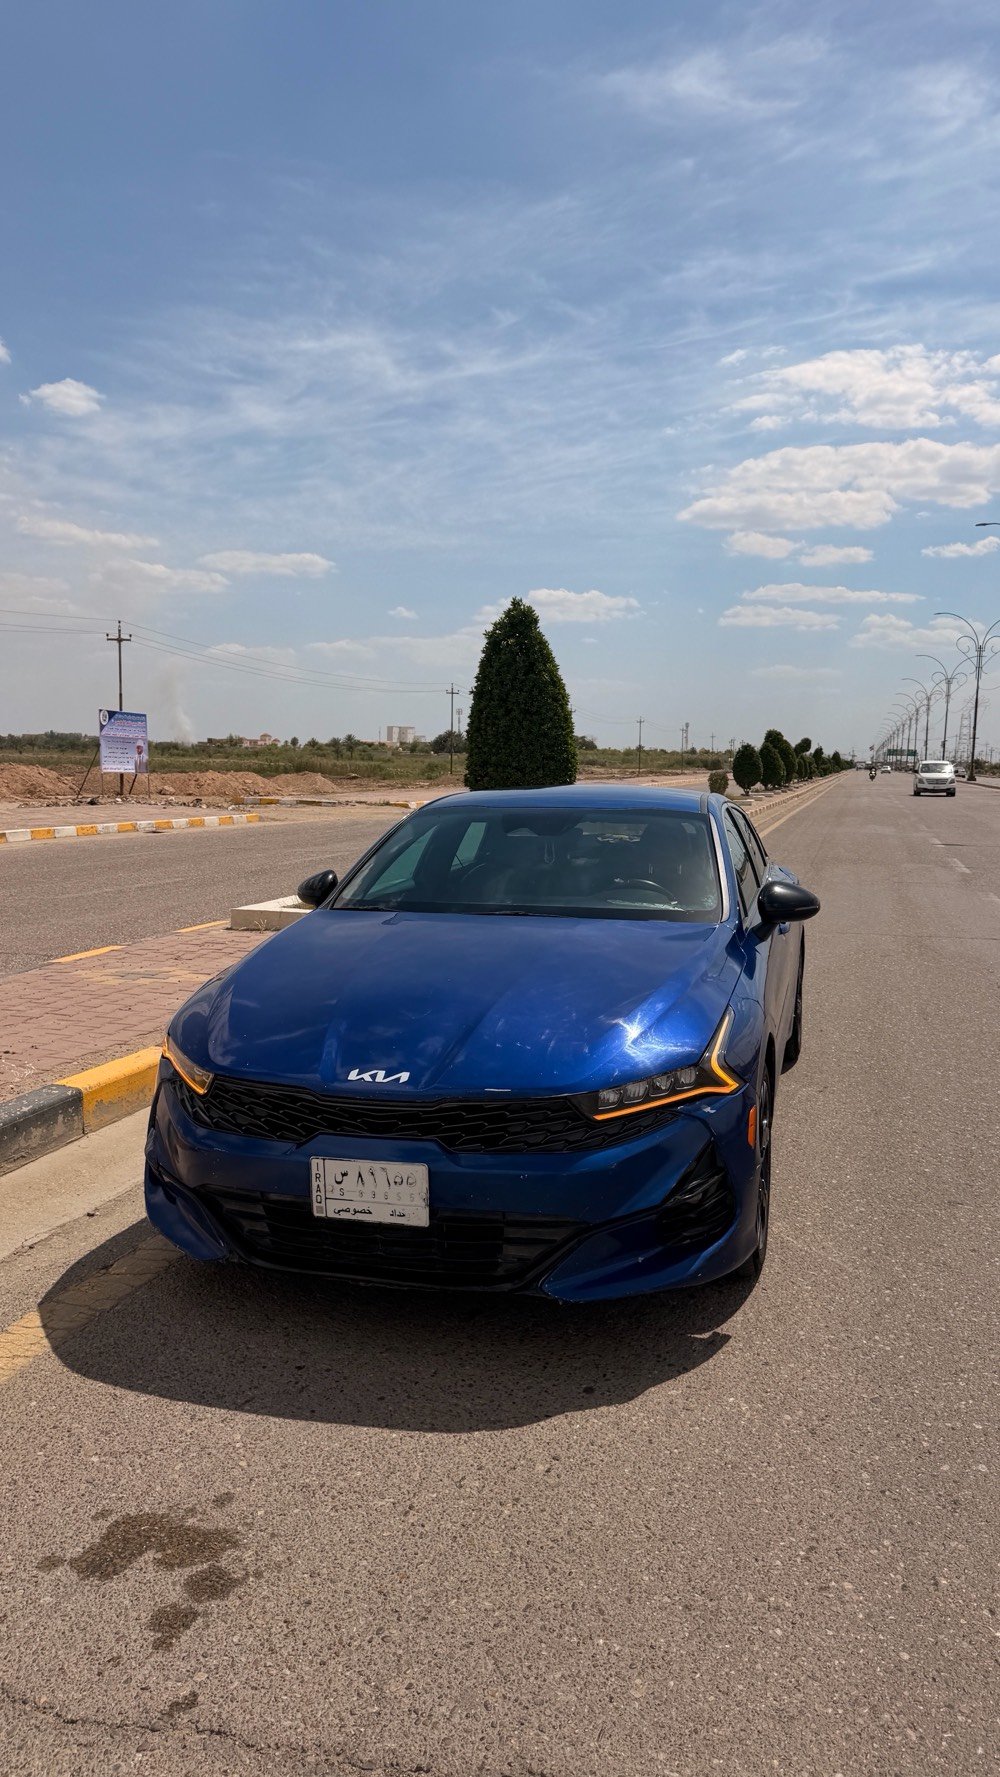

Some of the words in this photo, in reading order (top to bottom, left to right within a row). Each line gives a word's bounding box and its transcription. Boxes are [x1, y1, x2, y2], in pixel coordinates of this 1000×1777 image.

[347, 1068, 411, 1084] KIA
[314, 1162, 323, 1204] IRAQ
[334, 1169, 349, 1185] س
[339, 1187, 345, 1196] S
